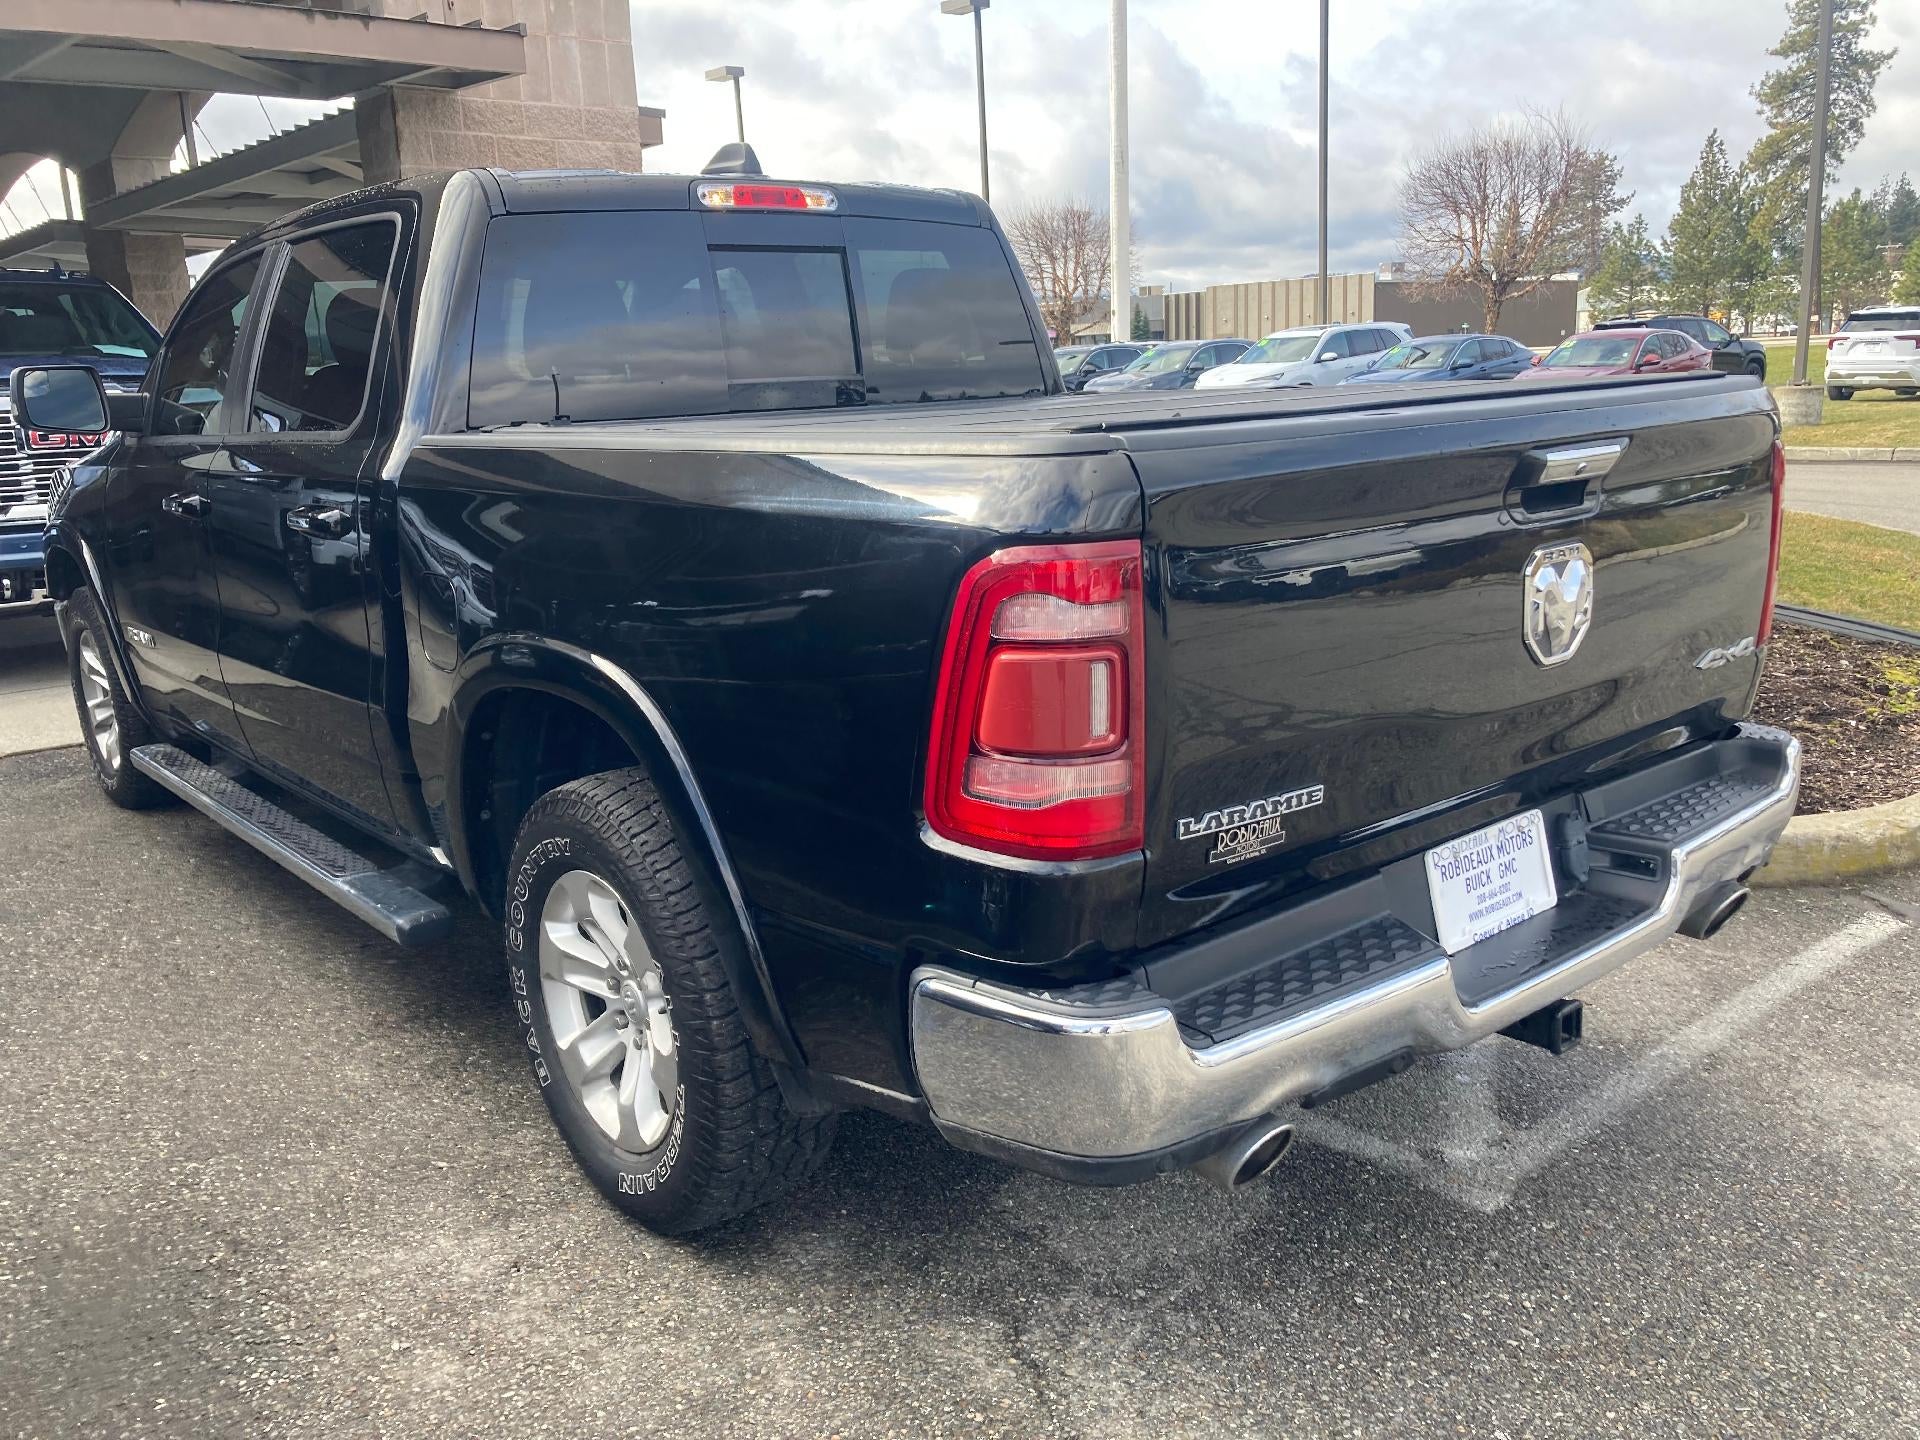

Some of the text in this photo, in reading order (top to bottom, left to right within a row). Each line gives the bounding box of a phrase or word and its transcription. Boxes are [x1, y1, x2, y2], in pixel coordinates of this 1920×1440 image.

[29, 430, 109, 449] GM
[1543, 547, 1580, 562] RAM
[1176, 784, 1324, 840] LARAMIE
[1217, 816, 1281, 854] ROBIDEAUX
[1432, 831, 1489, 870] ROBIDEAUX
[1440, 828, 1533, 882] ROBIDEAUX MOTORS
[1465, 857, 1518, 894] BUICK GMC
[509, 837, 571, 1088] BACK COUNTRY
[618, 1083, 686, 1195] TERRAIN
